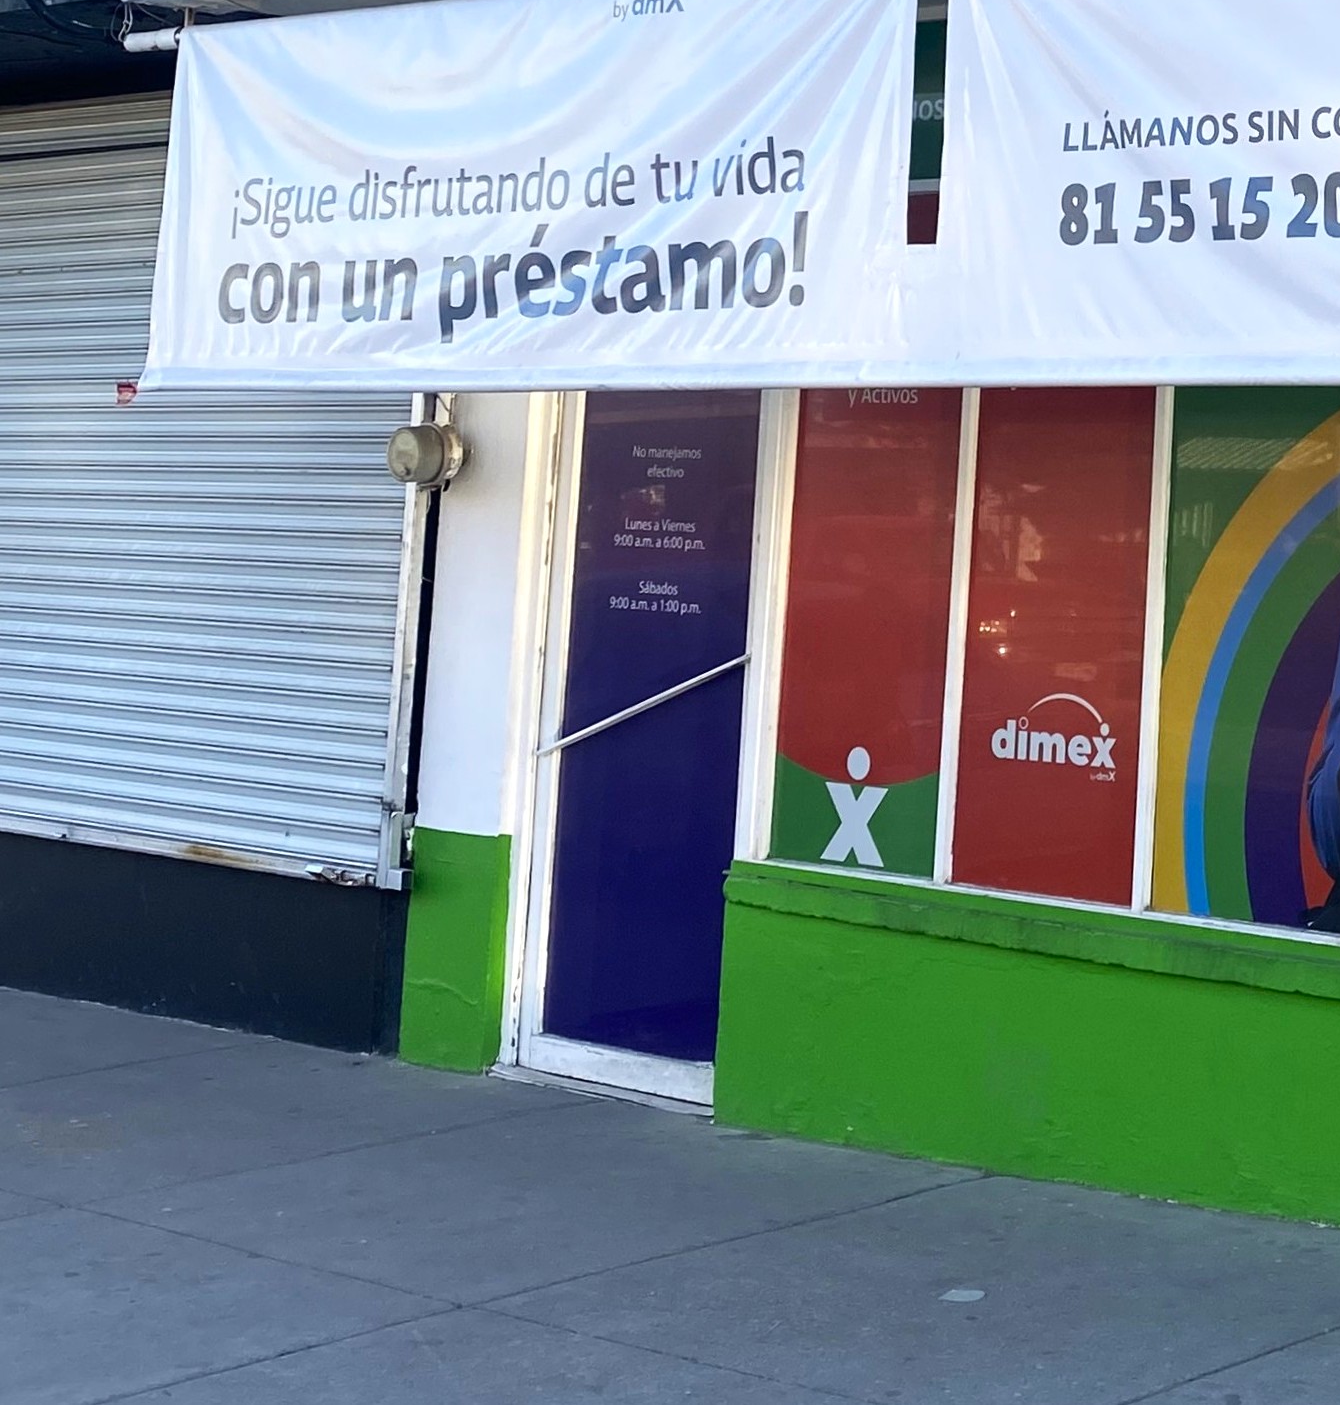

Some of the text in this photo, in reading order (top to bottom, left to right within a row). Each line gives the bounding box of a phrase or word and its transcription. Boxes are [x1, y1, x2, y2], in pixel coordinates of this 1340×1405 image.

[613, 0, 628, 22] by
[1063, 107, 1238, 152] LLÁMANOS
[1248, 109, 1301, 143] SIN
[231, 136, 805, 239] ¡Sigue disfrutando de tu vida
[1058, 181, 1117, 245] 81
[1134, 179, 1195, 243] 55
[1210, 175, 1273, 241] 15
[218, 210, 808, 345] con un préstamo!
[861, 388, 918, 404] Activos
[632, 446, 702, 461] No manejamos
[647, 465, 685, 478] efectivo
[625, 518, 696, 533] Lunes a Viernes
[613, 534, 634, 547] 9:00
[655, 539, 662, 548] a
[663, 536, 684, 549] 6:00
[639, 581, 678, 595] Sábados
[609, 596, 629, 609] 9:00
[651, 602, 658, 611] a
[660, 599, 679, 612] 1:00
[991, 716, 1116, 768] dimex
